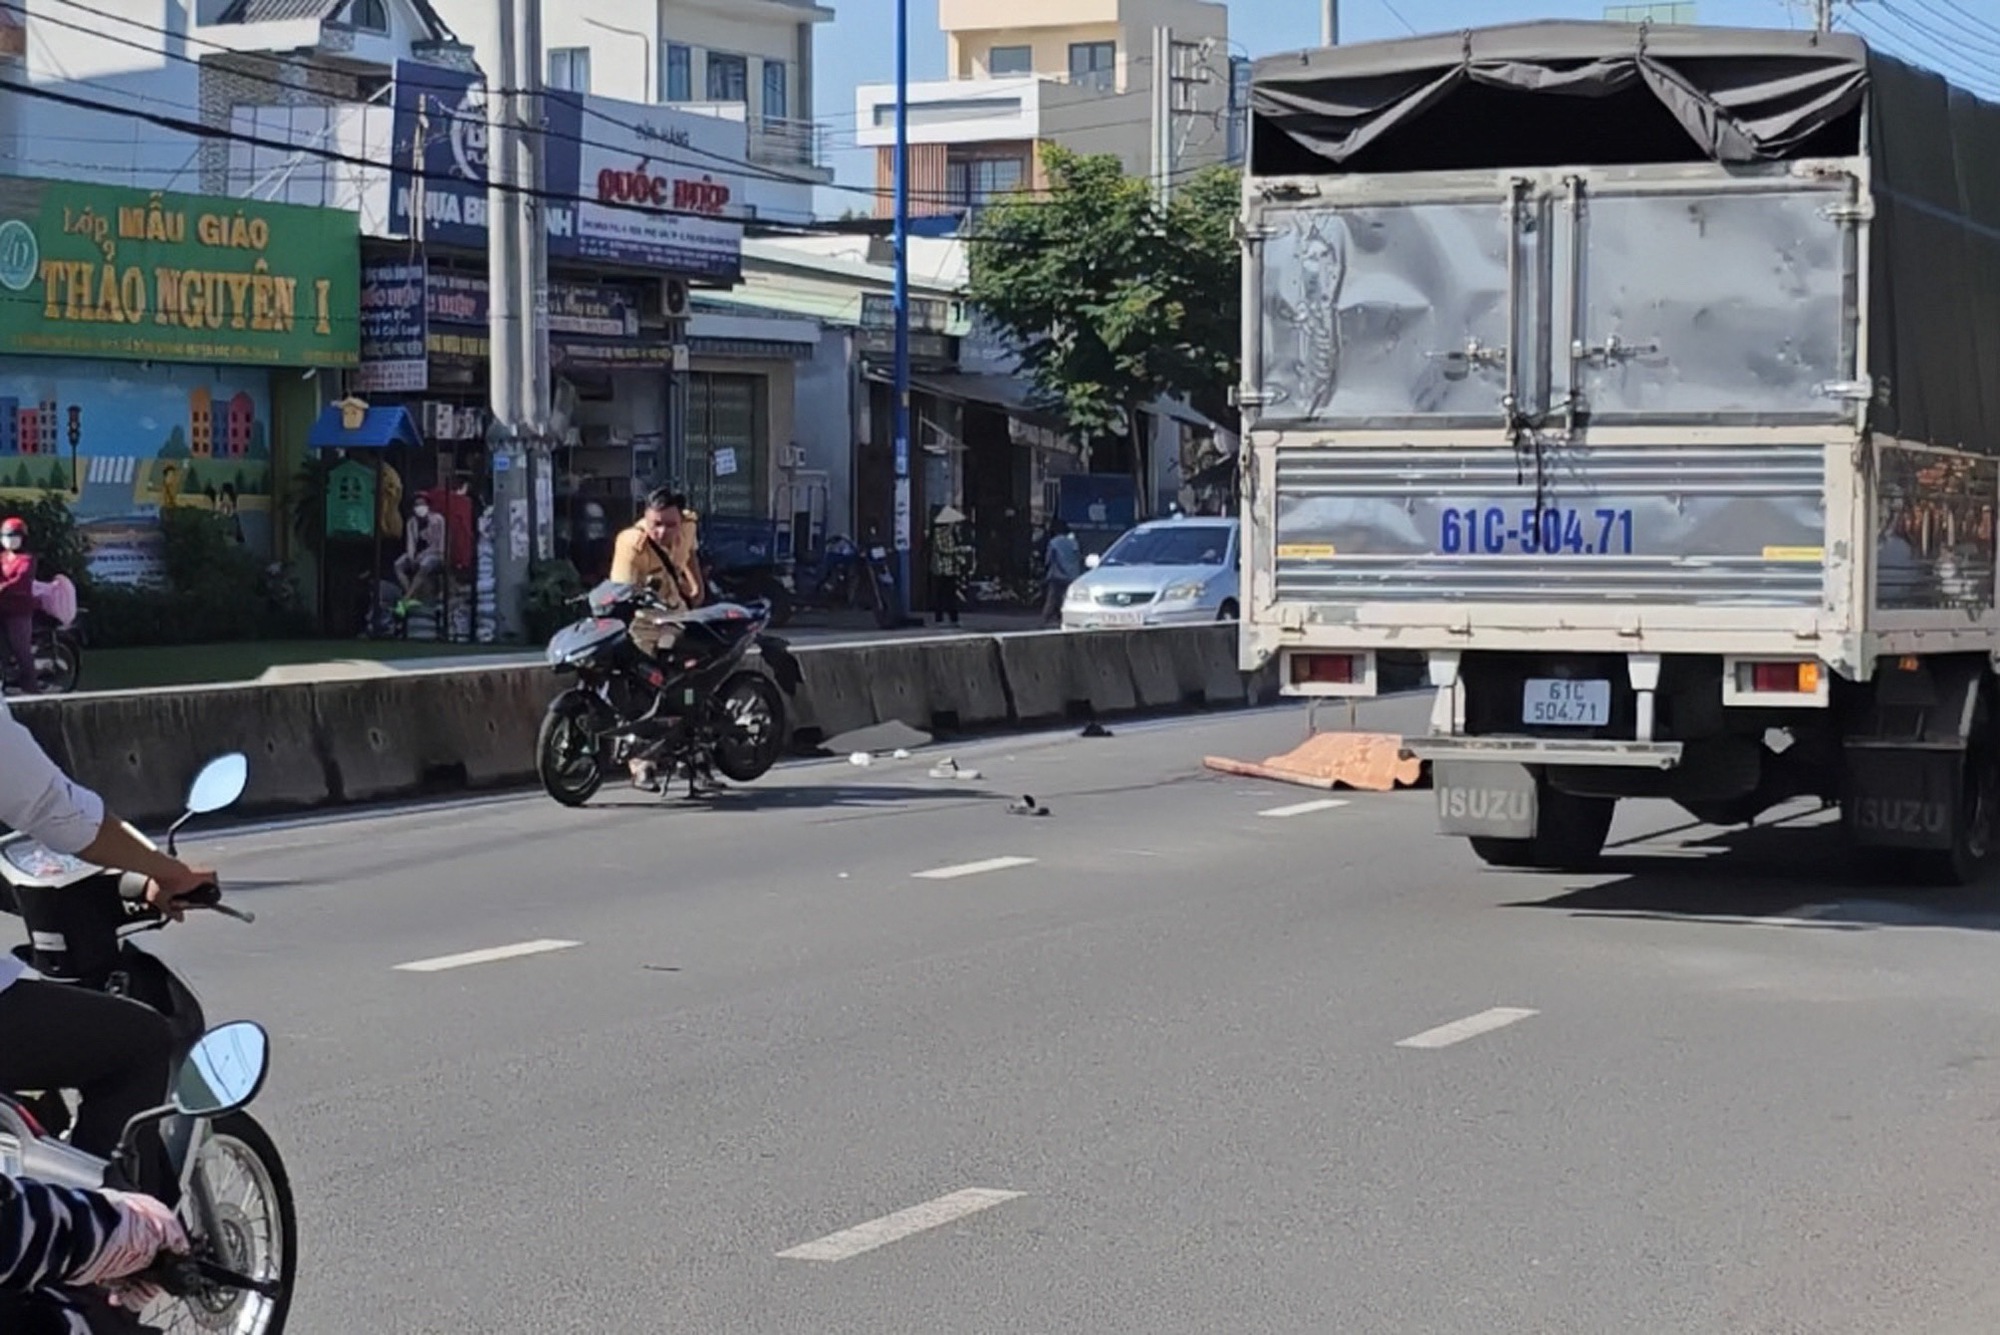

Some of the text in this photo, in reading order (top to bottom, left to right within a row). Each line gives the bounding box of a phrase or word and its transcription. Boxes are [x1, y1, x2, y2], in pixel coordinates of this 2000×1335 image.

[118, 192, 185, 243] MẪU
[198, 208, 270, 250] GIÁO
[41, 240, 147, 324] THẢO
[155, 258, 297, 333] NGUYÊN
[1441, 507, 1633, 555] 61C-504.71
[1549, 682, 1585, 700] 61C
[1534, 702, 1597, 721] 504.71
[1440, 785, 1530, 820] ISUZU
[1853, 796, 1946, 833] ISUZU
